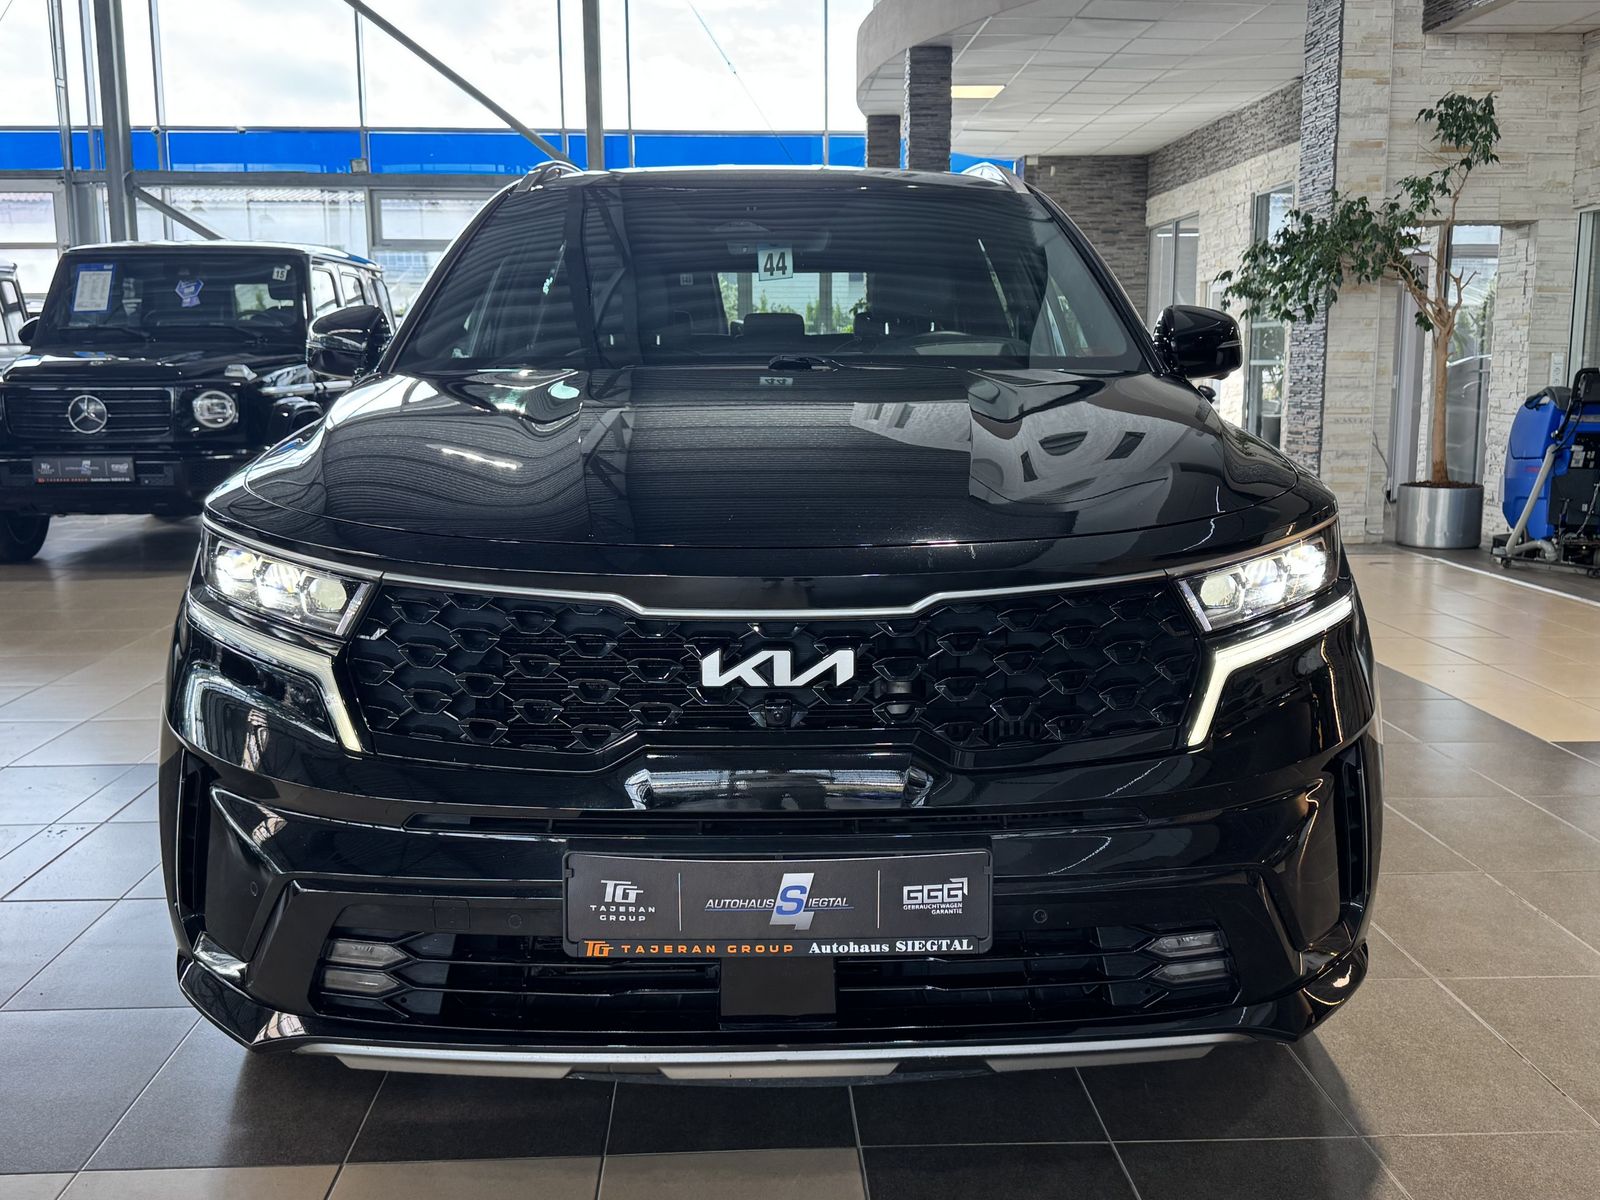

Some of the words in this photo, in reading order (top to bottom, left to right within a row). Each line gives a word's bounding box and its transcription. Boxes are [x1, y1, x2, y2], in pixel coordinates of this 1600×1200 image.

[764, 252, 787, 276] 44
[276, 270, 285, 279] 15
[702, 649, 854, 687] KIA
[903, 882, 963, 905] GGG
[590, 905, 655, 913] TAJERAN
[705, 898, 775, 909] AUTOHAUS
[903, 903, 963, 911] GEBRAUCHTWAGEN
[621, 945, 716, 954] TAJERAN
[727, 944, 794, 953] GROUP
[809, 942, 890, 954] Autohaus
[895, 939, 974, 952] SIEGTAL
